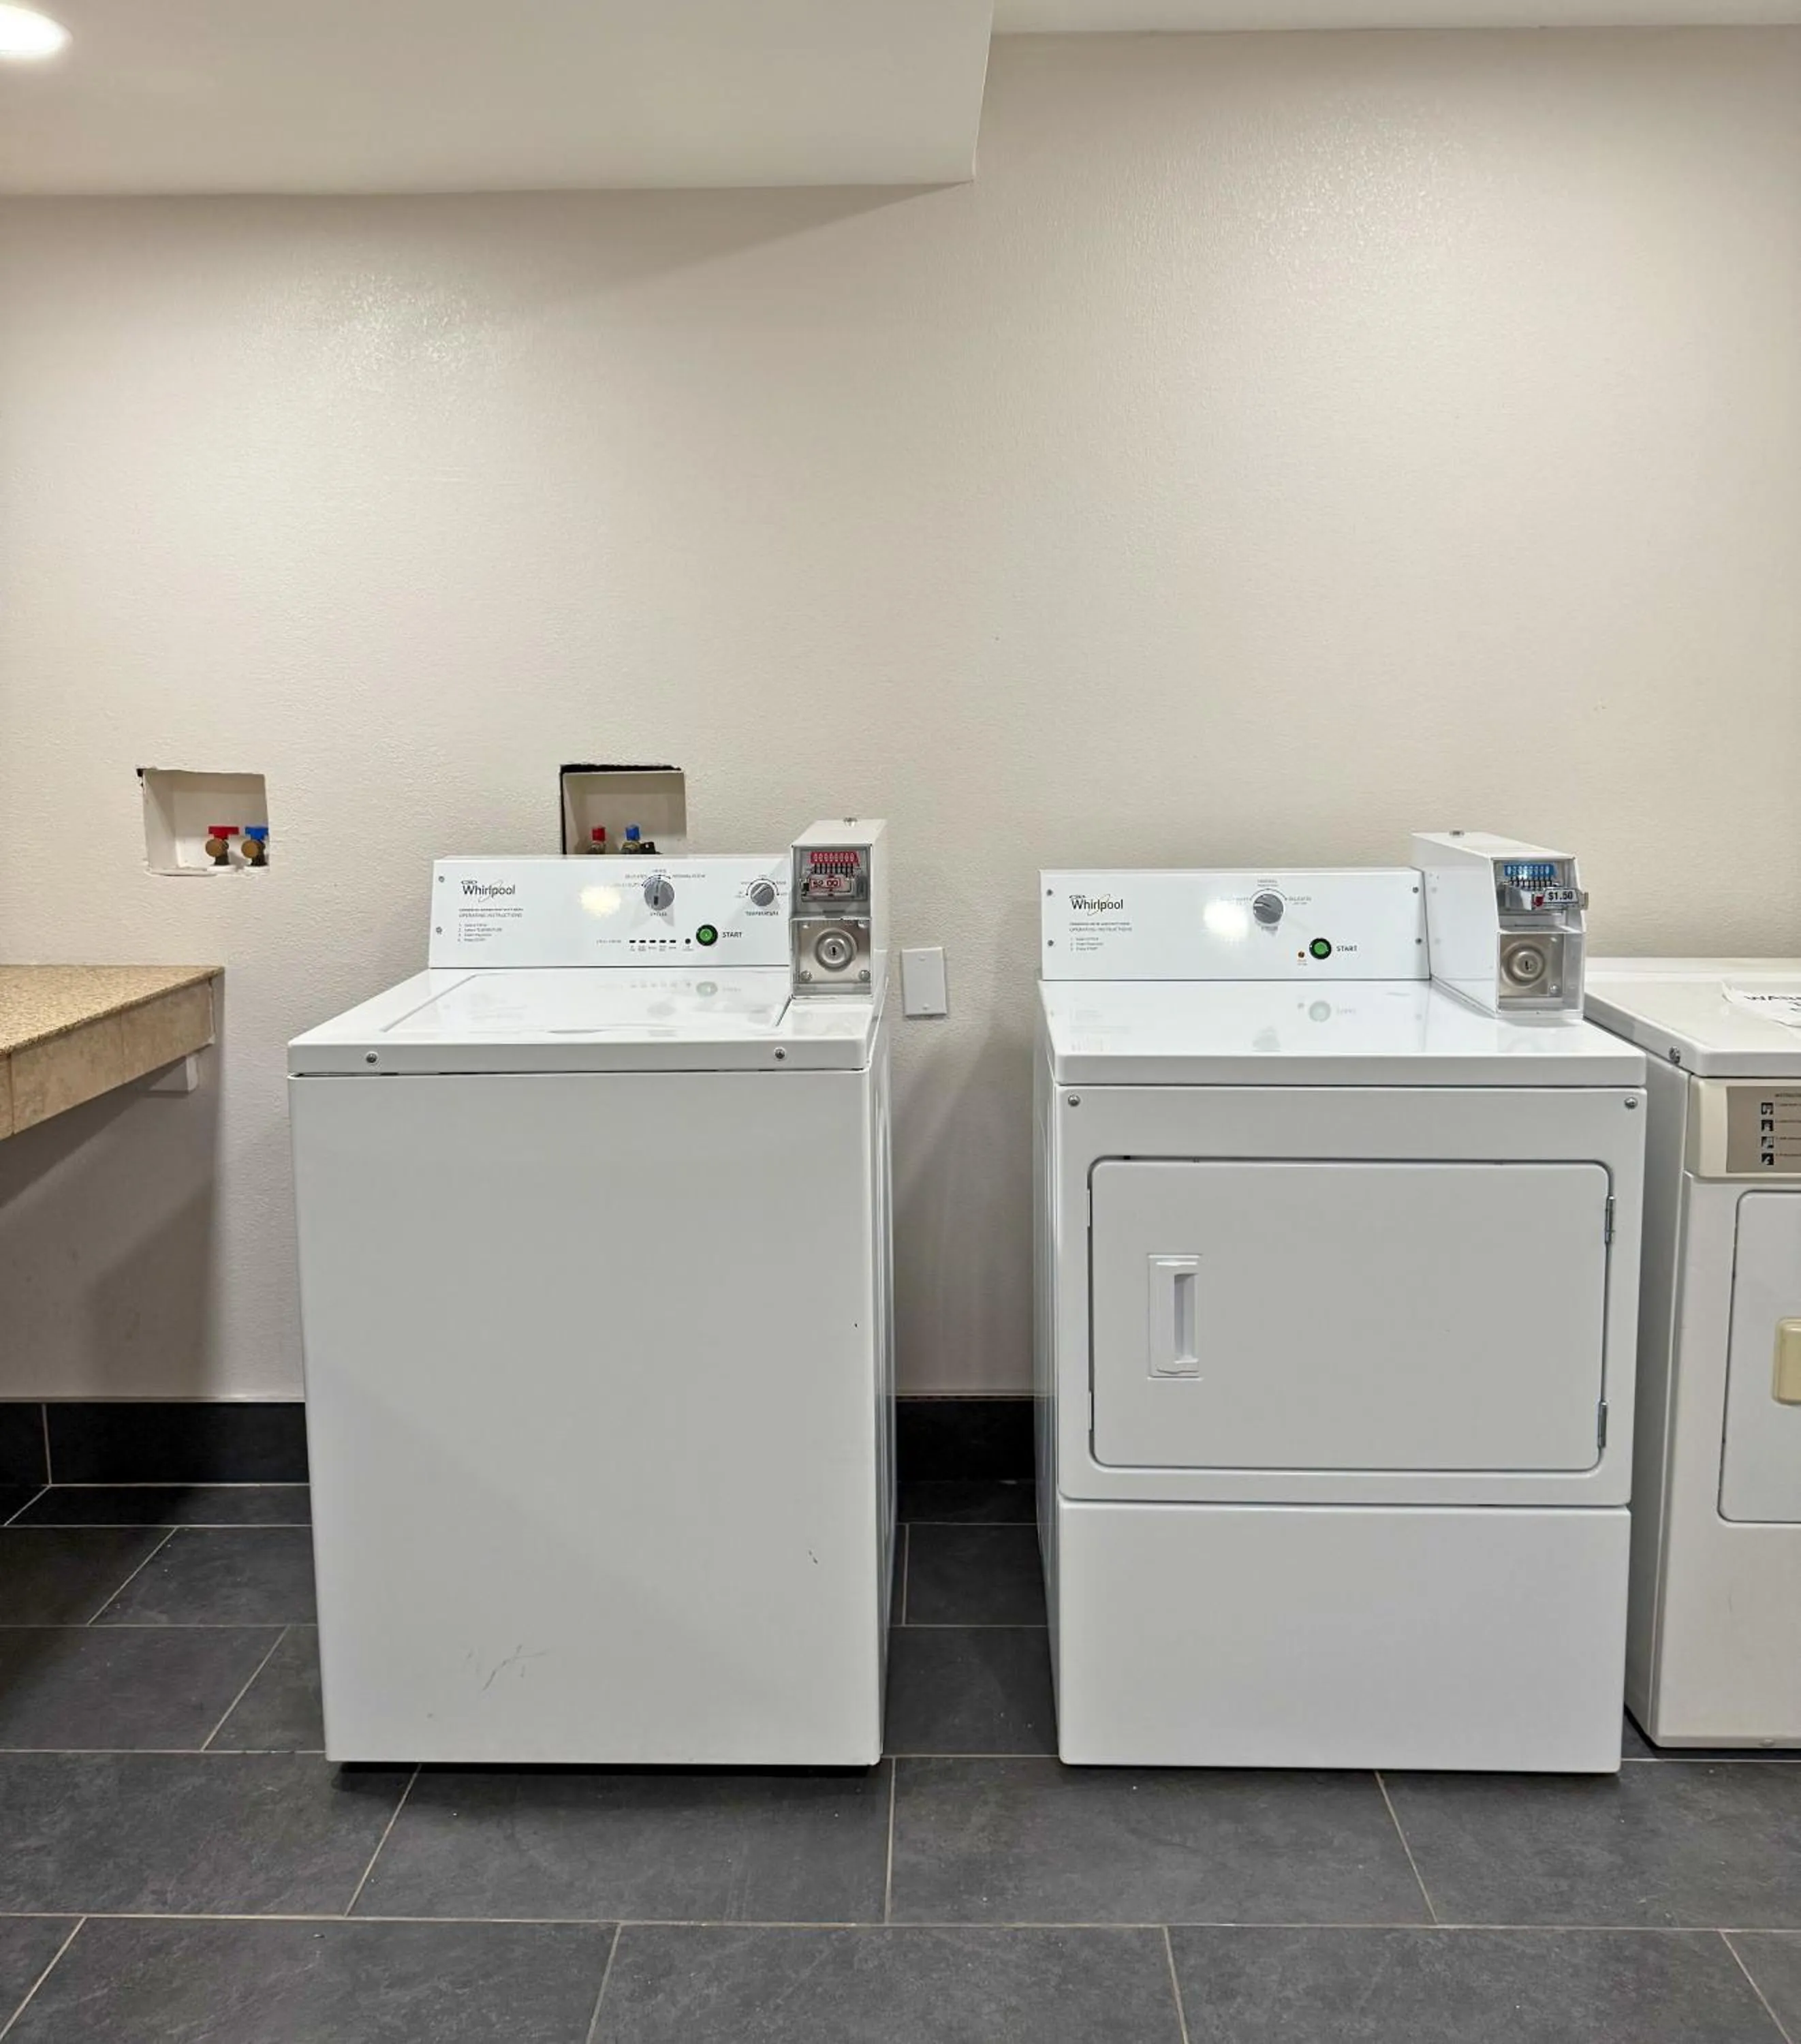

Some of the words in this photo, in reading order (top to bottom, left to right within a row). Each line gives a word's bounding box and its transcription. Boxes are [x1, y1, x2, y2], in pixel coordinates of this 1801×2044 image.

[463, 884, 516, 898] Whirlpool
[1548, 891, 1573, 901] $1.50
[1071, 899, 1123, 912] Whirlpool
